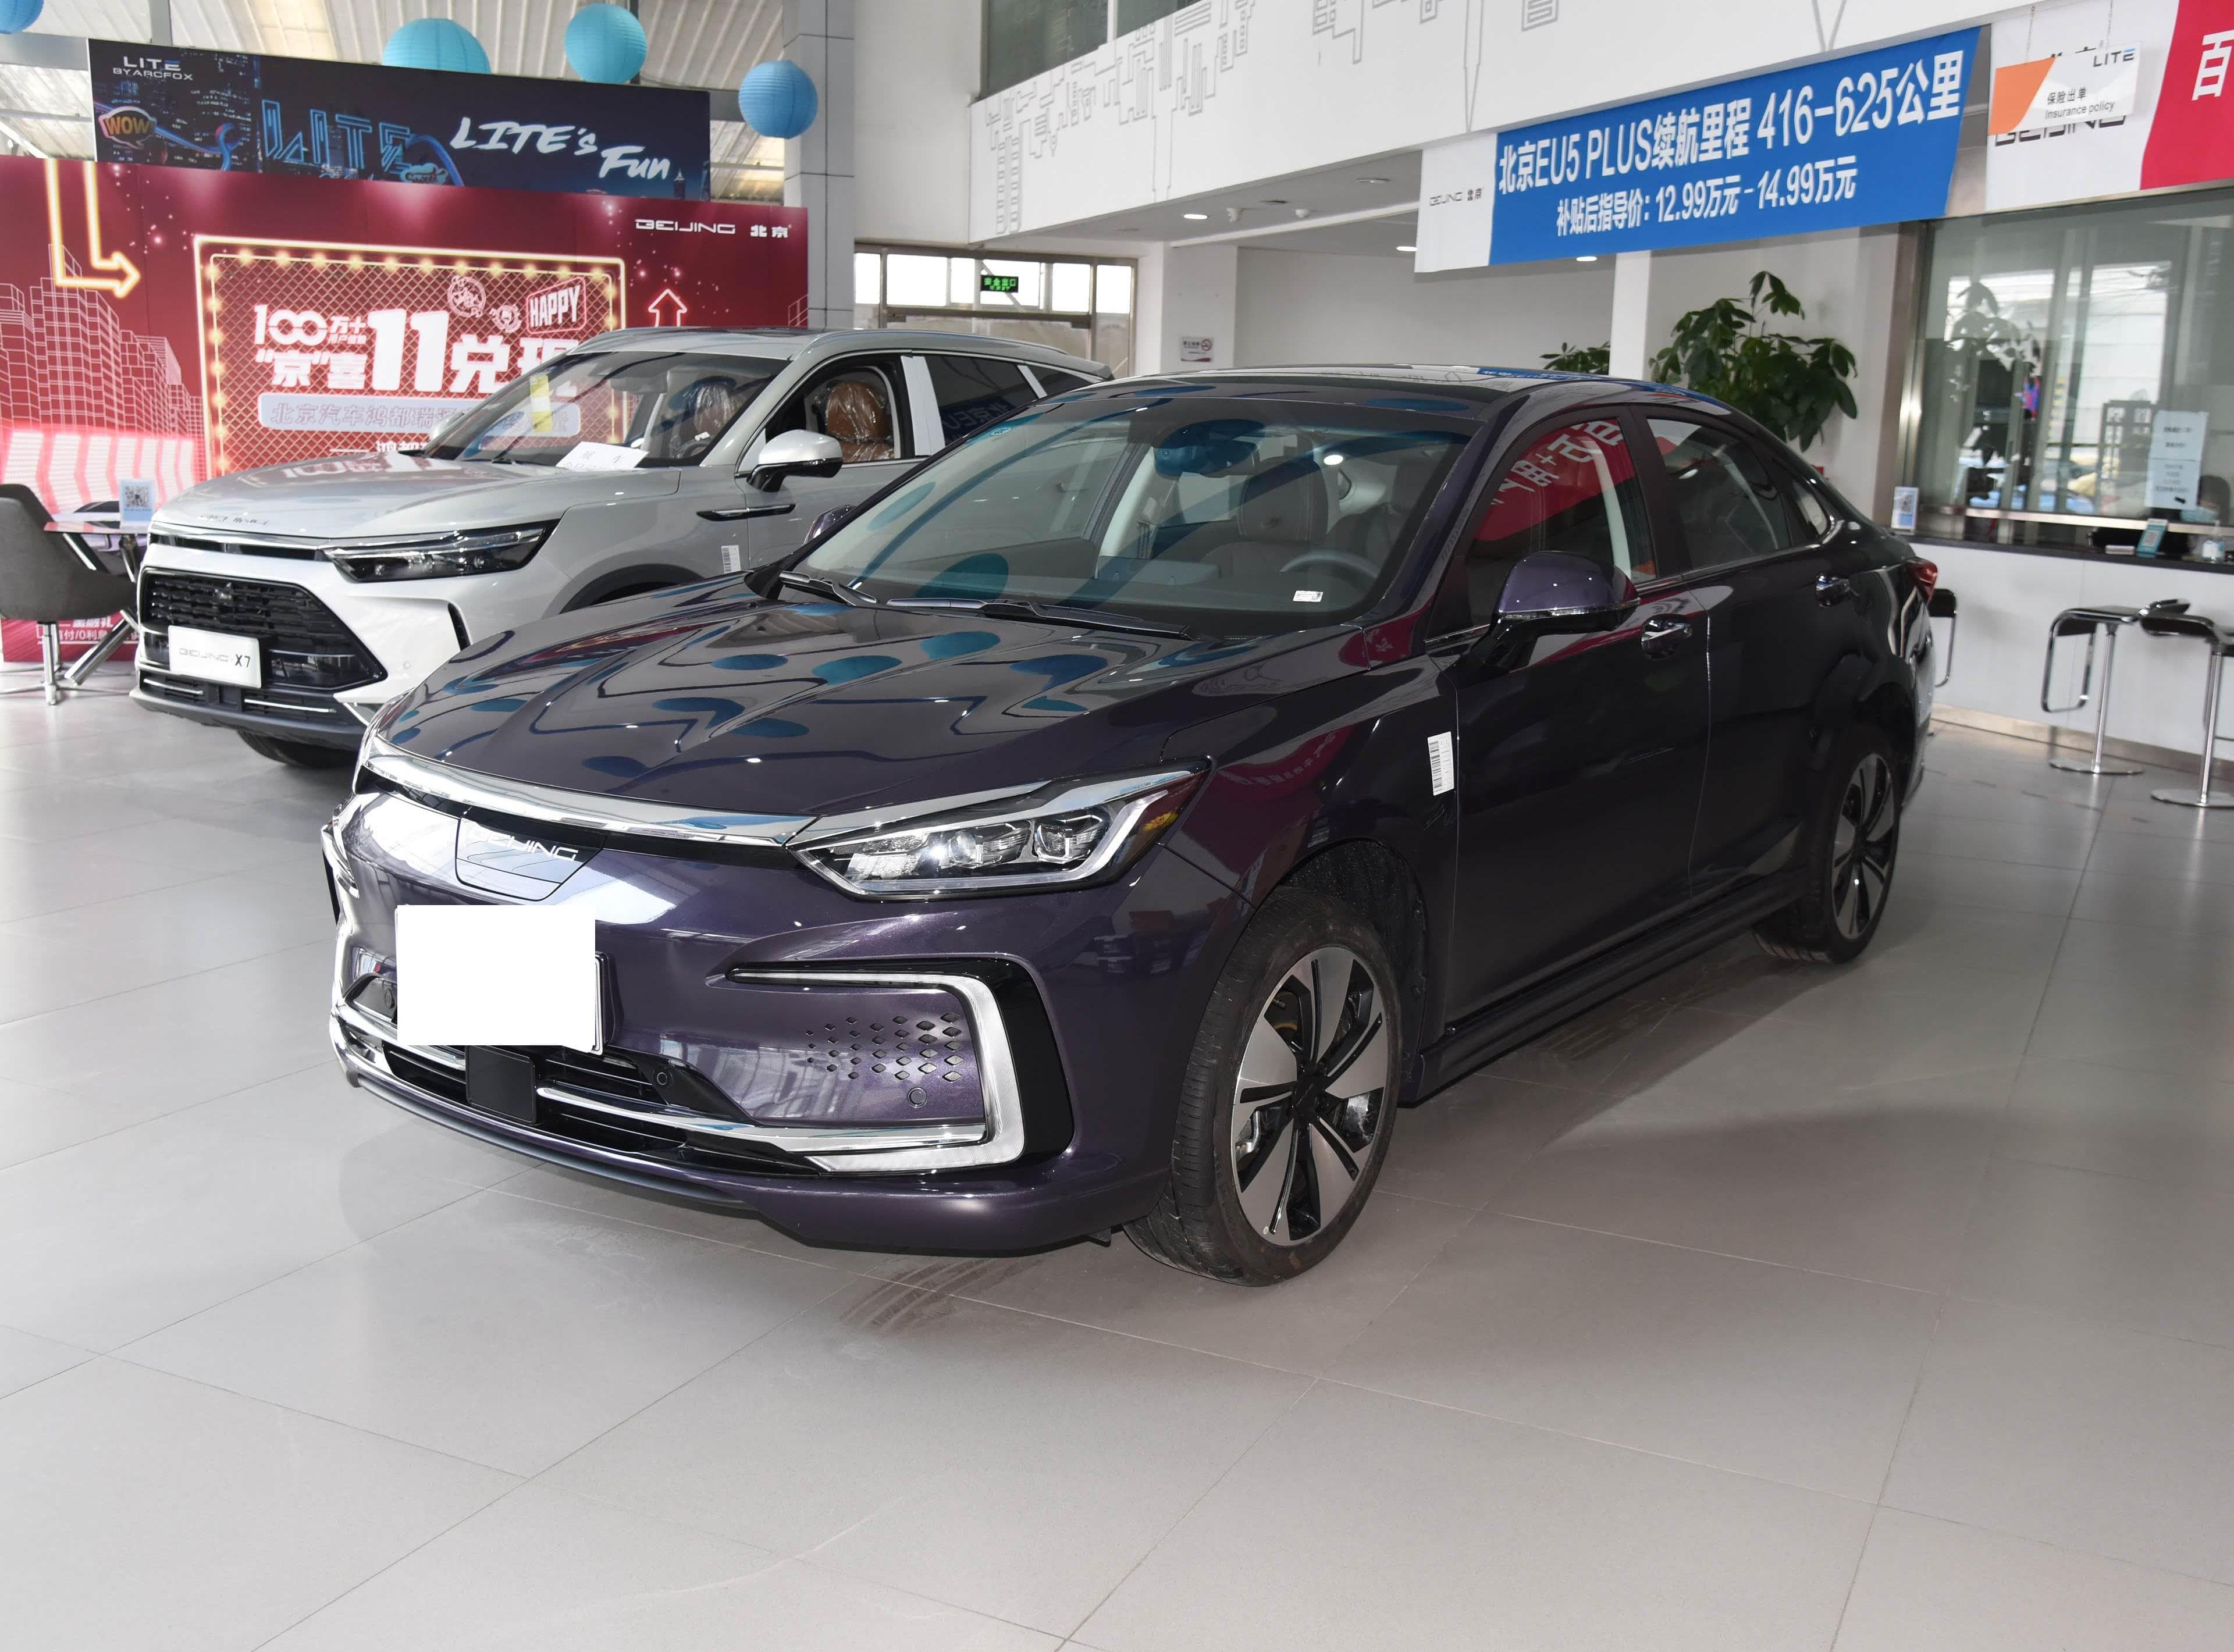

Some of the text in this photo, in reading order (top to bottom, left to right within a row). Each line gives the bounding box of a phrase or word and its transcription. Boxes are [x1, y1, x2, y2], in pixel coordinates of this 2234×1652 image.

[123, 56, 181, 71] LITE
[2093, 44, 2136, 67] LITE
[2047, 87, 2087, 105] 保险出单
[2046, 101, 2115, 119] Insurance policy
[1499, 50, 1963, 195] 北京EU5 PLUS续航里程 416-625公里
[450, 117, 597, 155] LITE's
[599, 145, 670, 180] Fun
[635, 219, 788, 238] BEIJING 北京
[530, 285, 581, 327] HAPPY
[179, 647, 251, 668] BEIJING X7
